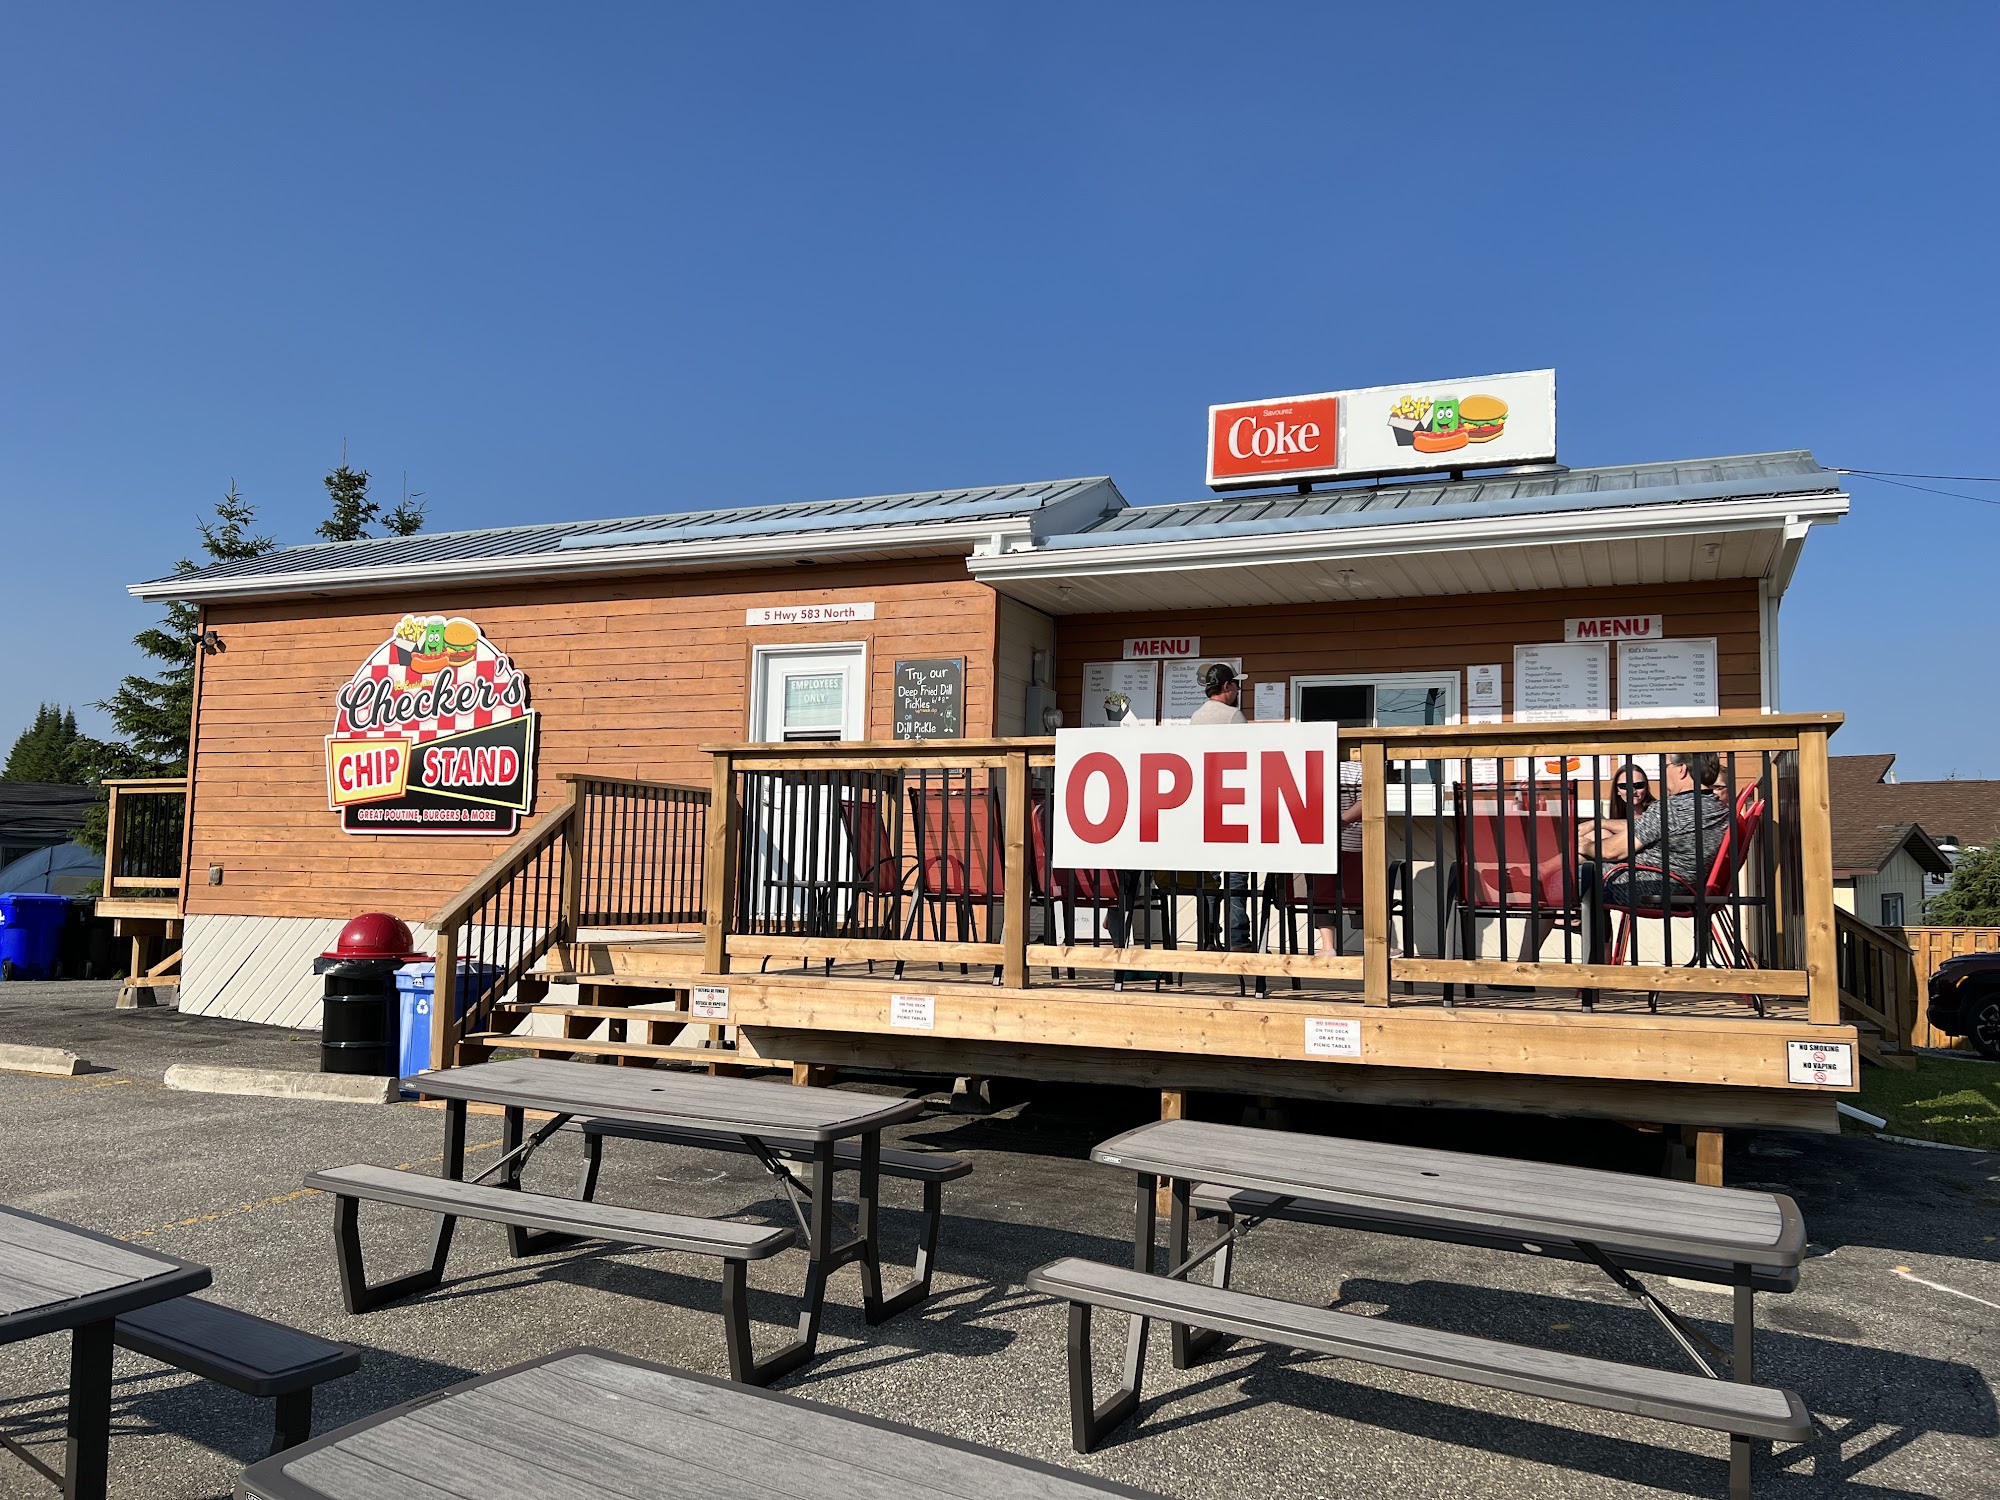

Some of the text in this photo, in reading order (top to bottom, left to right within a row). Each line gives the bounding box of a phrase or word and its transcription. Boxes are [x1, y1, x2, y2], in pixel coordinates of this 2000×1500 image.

[1263, 408, 1293, 417] Savourez
[1228, 416, 1320, 459] Coke
[764, 607, 855, 623] 5 Hwy 583 North
[1576, 619, 1649, 638] MENU
[1133, 640, 1190, 656] MENU
[792, 679, 839, 690] EMPLOYEES
[905, 668, 948, 685] Try our
[340, 659, 521, 729] Checker's
[804, 694, 825, 703] ONLY
[898, 684, 952, 699] Deep Fried Dill
[897, 722, 911, 733] Dill
[338, 749, 517, 790] CHIP STAND
[1066, 750, 1324, 844] OPEN
[359, 810, 495, 822] GREAT POUTINE, BURGERS & MORE
